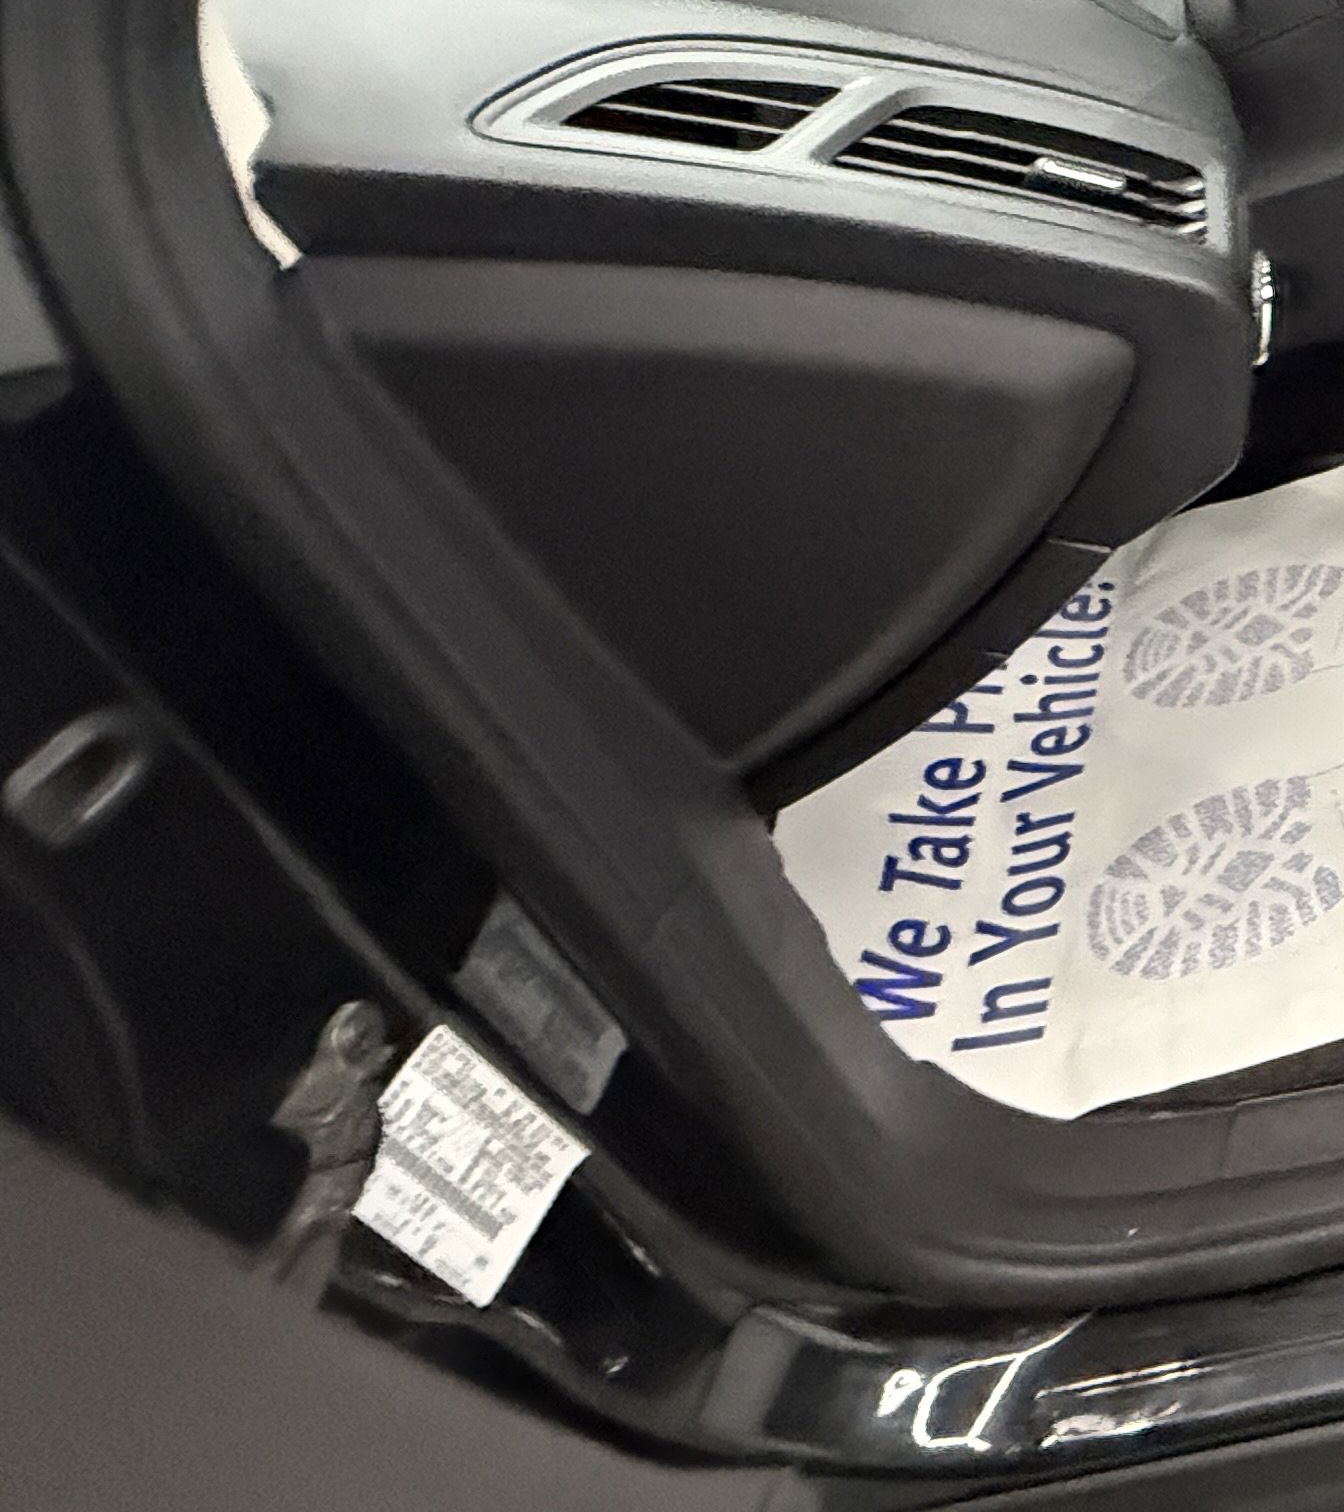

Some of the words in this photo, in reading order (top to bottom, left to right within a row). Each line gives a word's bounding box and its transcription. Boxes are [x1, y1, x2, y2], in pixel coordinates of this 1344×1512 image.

[878, 757, 986, 891] Take
[968, 812, 1076, 967] Your
[853, 918, 952, 1021] We
[952, 976, 1053, 1051] In
